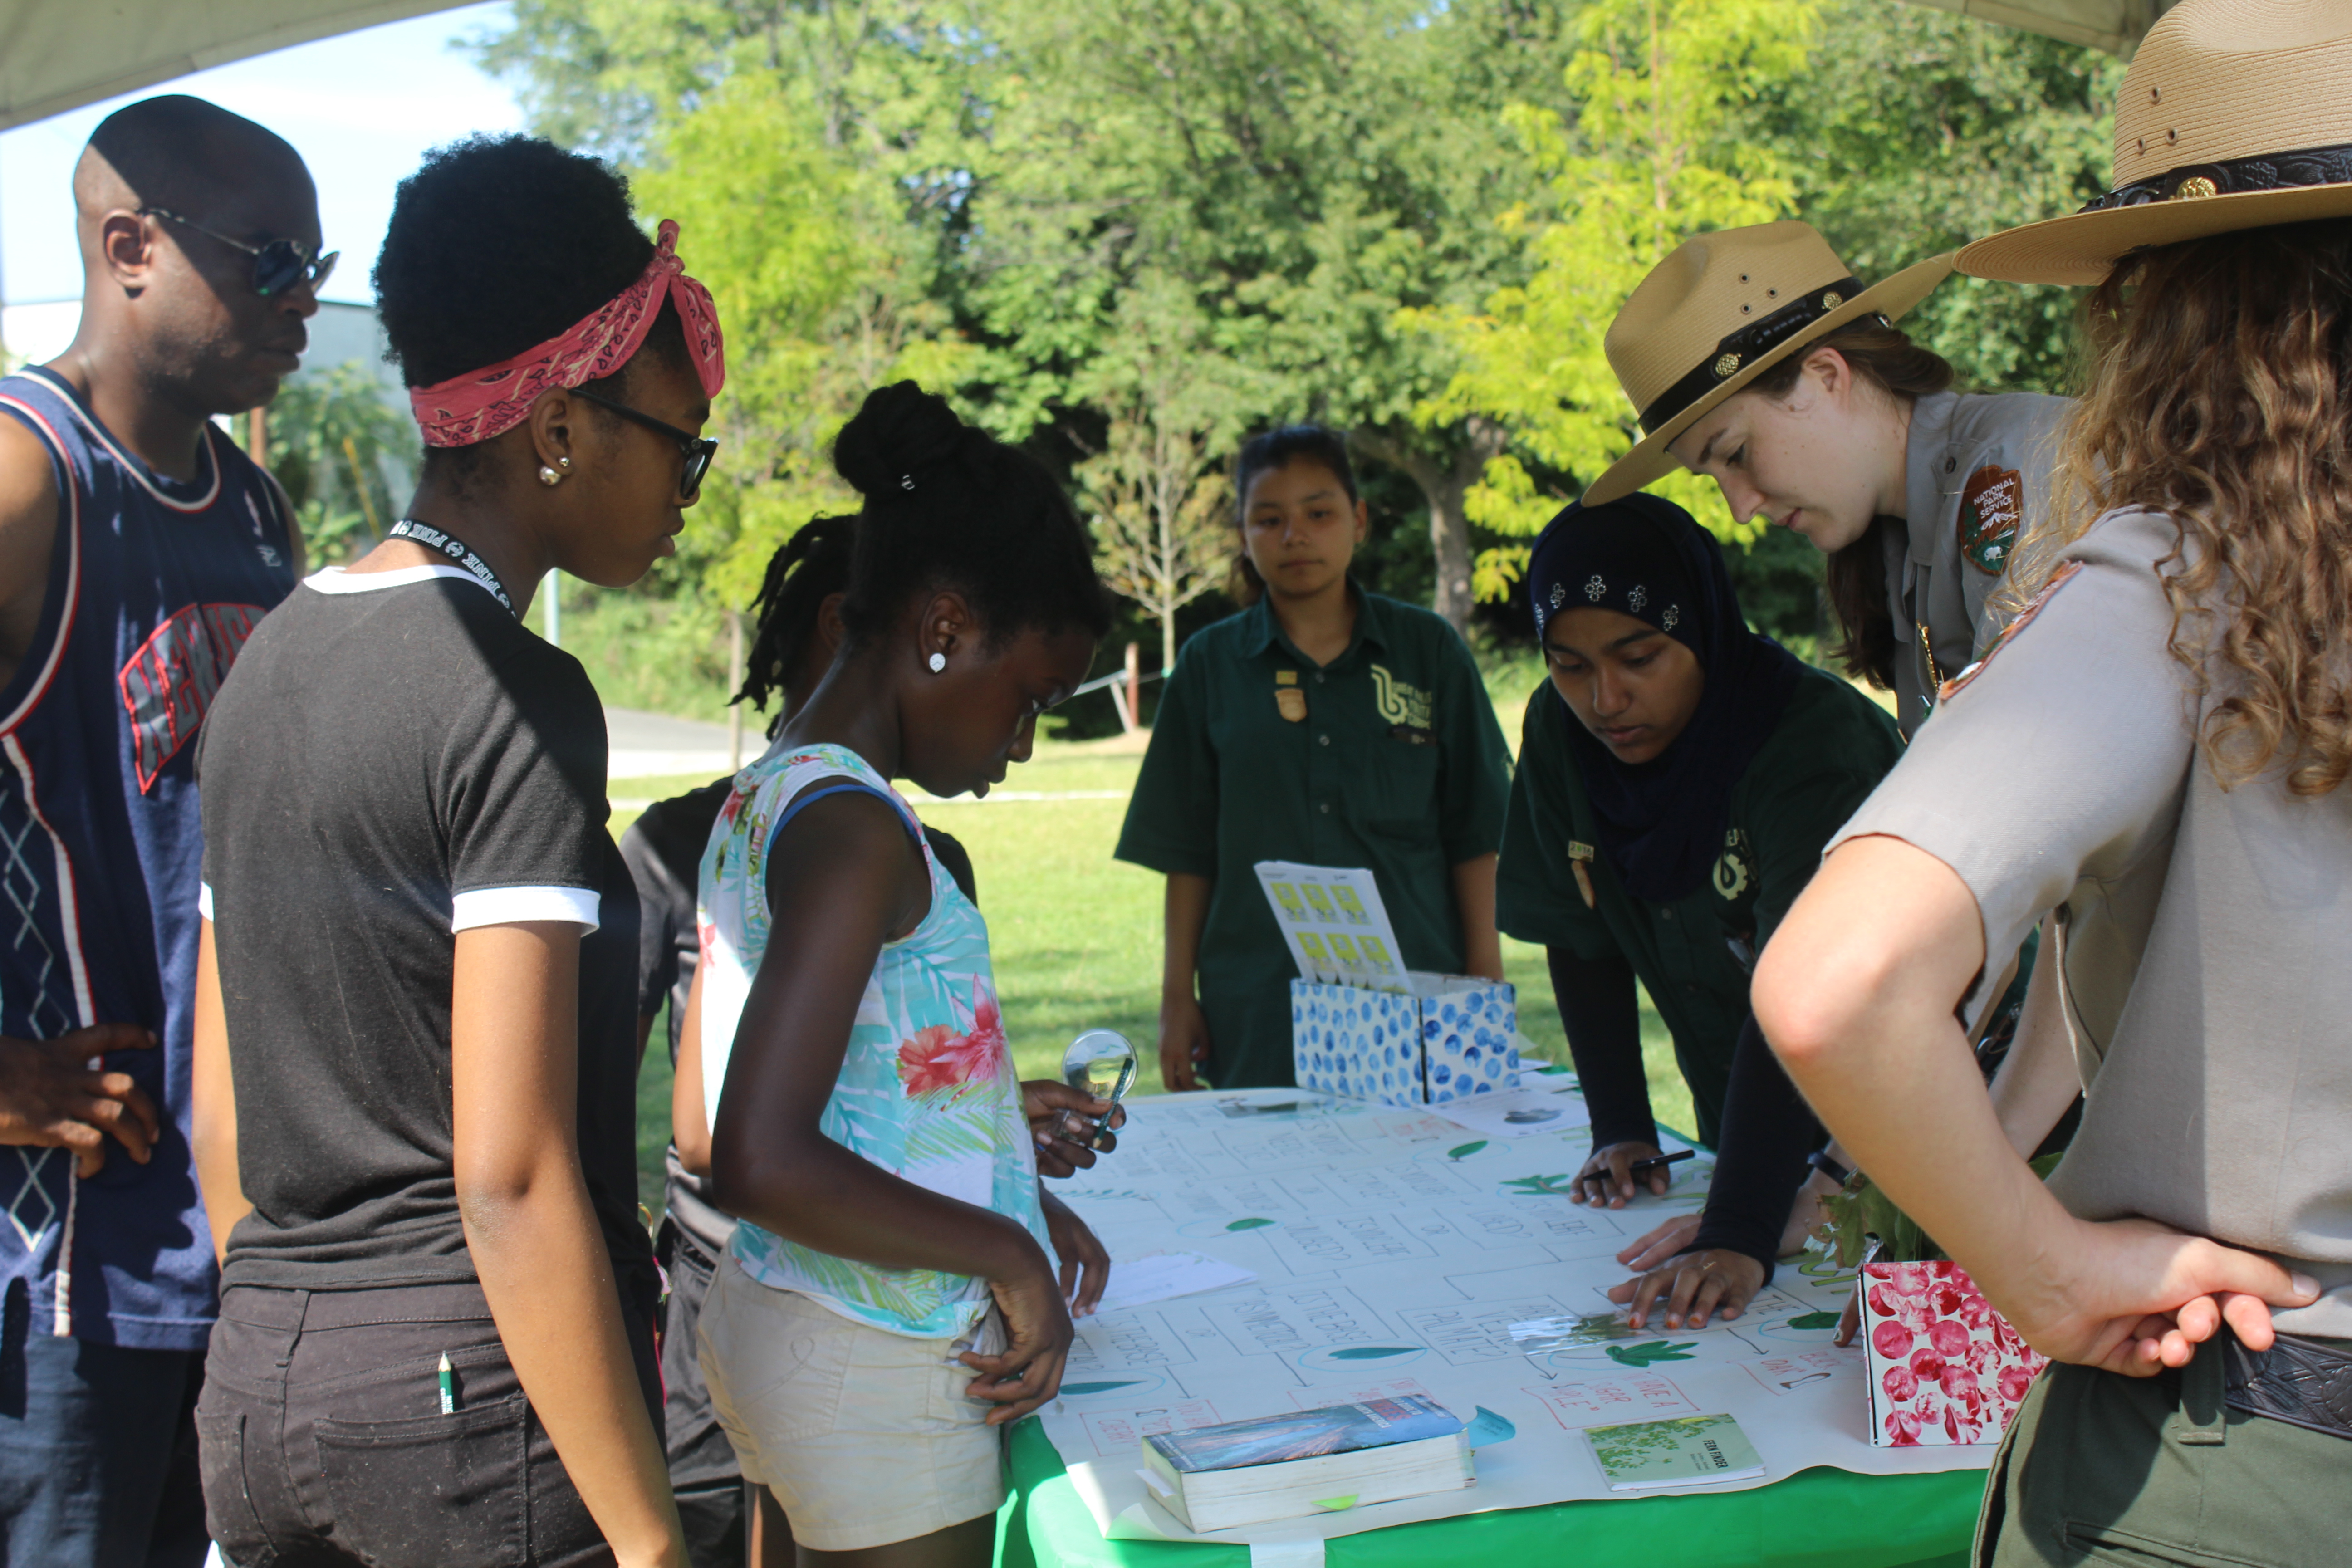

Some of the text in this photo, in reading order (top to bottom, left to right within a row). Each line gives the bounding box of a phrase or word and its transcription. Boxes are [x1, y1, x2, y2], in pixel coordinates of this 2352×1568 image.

[1974, 478, 2015, 505] NATIONAL
[1983, 490, 2005, 508] PARK
[1980, 495, 2014, 519] SERVICE
[408, 523, 448, 548] PINK
[461, 552, 501, 594] PINK
[1544, 1218, 1596, 1236] LEAF
[1288, 1291, 1372, 1343] IS THE BASE
[1102, 1326, 1154, 1344] THE
[1413, 1311, 1509, 1357] PALMATE?
[1115, 1343, 1169, 1366] BASE
[1634, 1381, 1671, 1399] HAVE
[1362, 1399, 1413, 1421] TREES
[1702, 1440, 1720, 1451] FERN
[1709, 1451, 1729, 1469] FINDER
